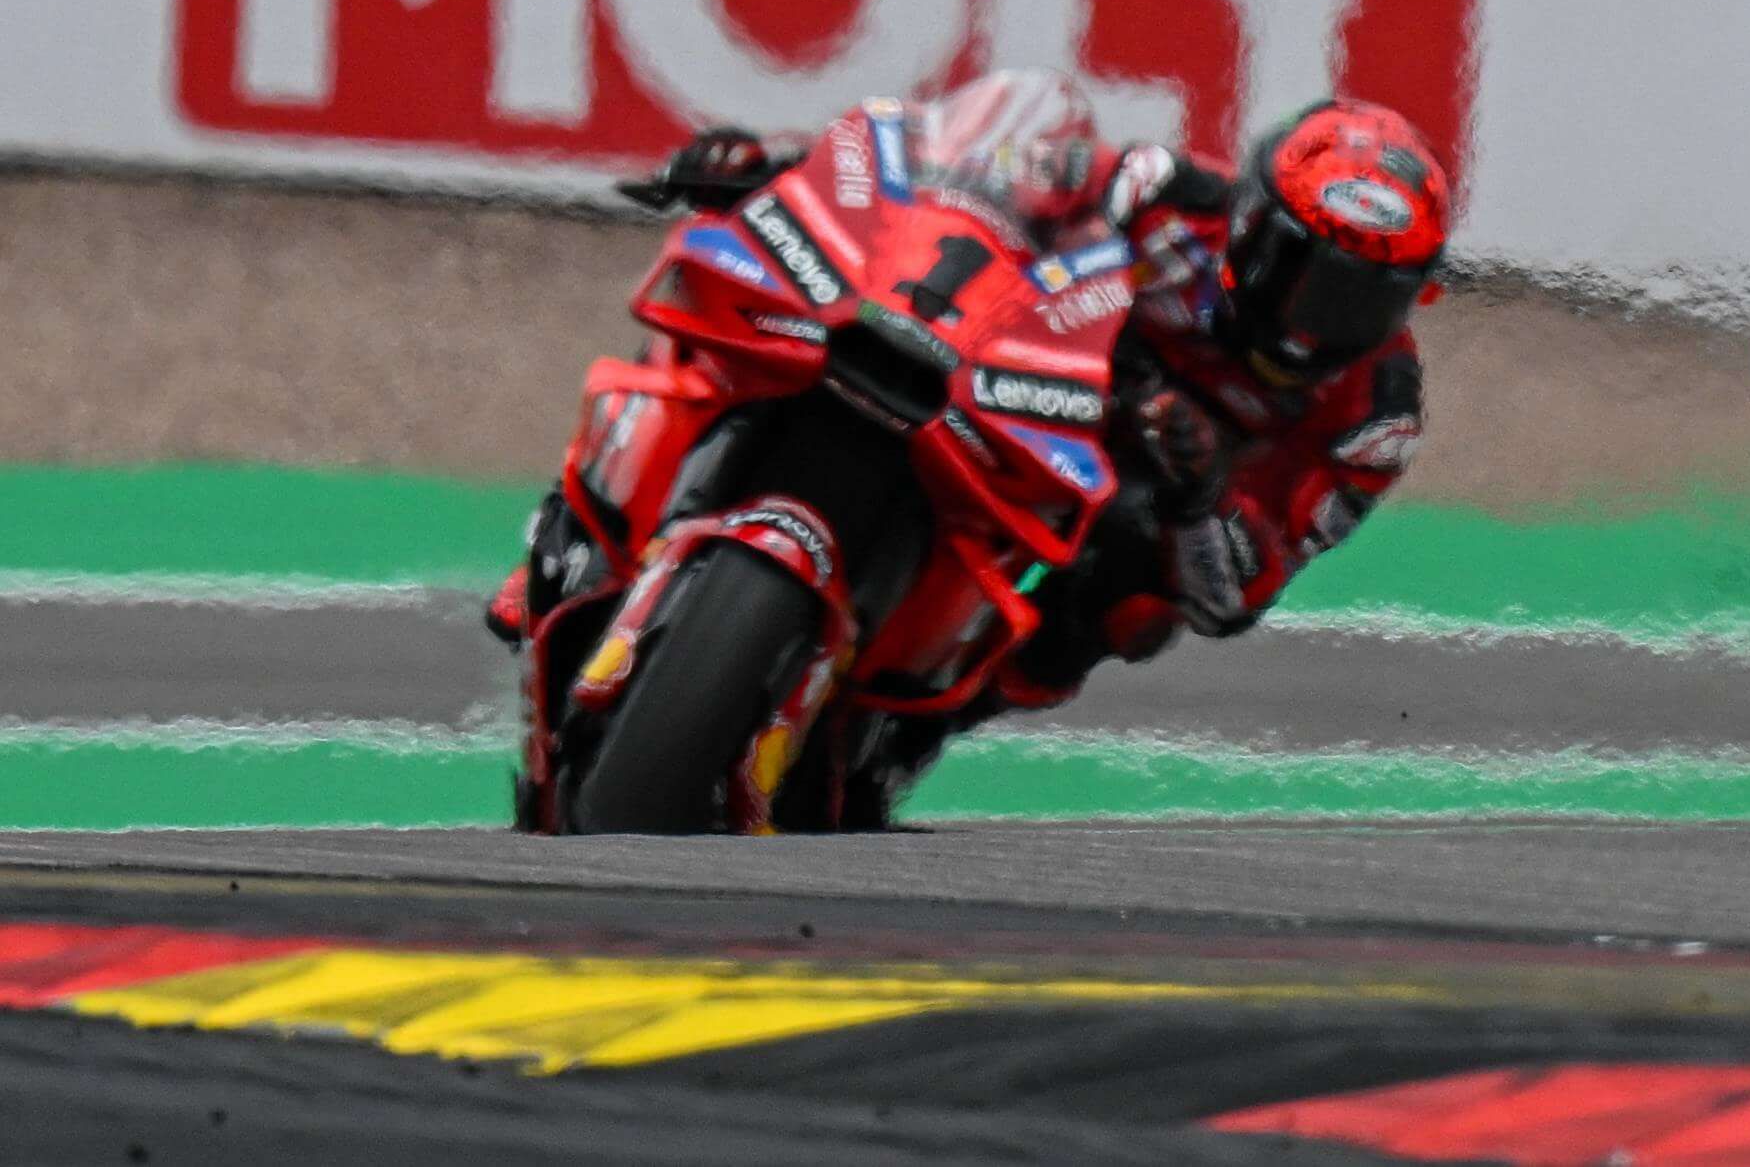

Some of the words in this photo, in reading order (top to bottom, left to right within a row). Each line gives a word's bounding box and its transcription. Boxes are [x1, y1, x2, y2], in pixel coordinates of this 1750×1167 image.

[743, 190, 841, 305] Lenovo
[893, 235, 994, 325] 1
[971, 367, 1103, 422] Lenovo
